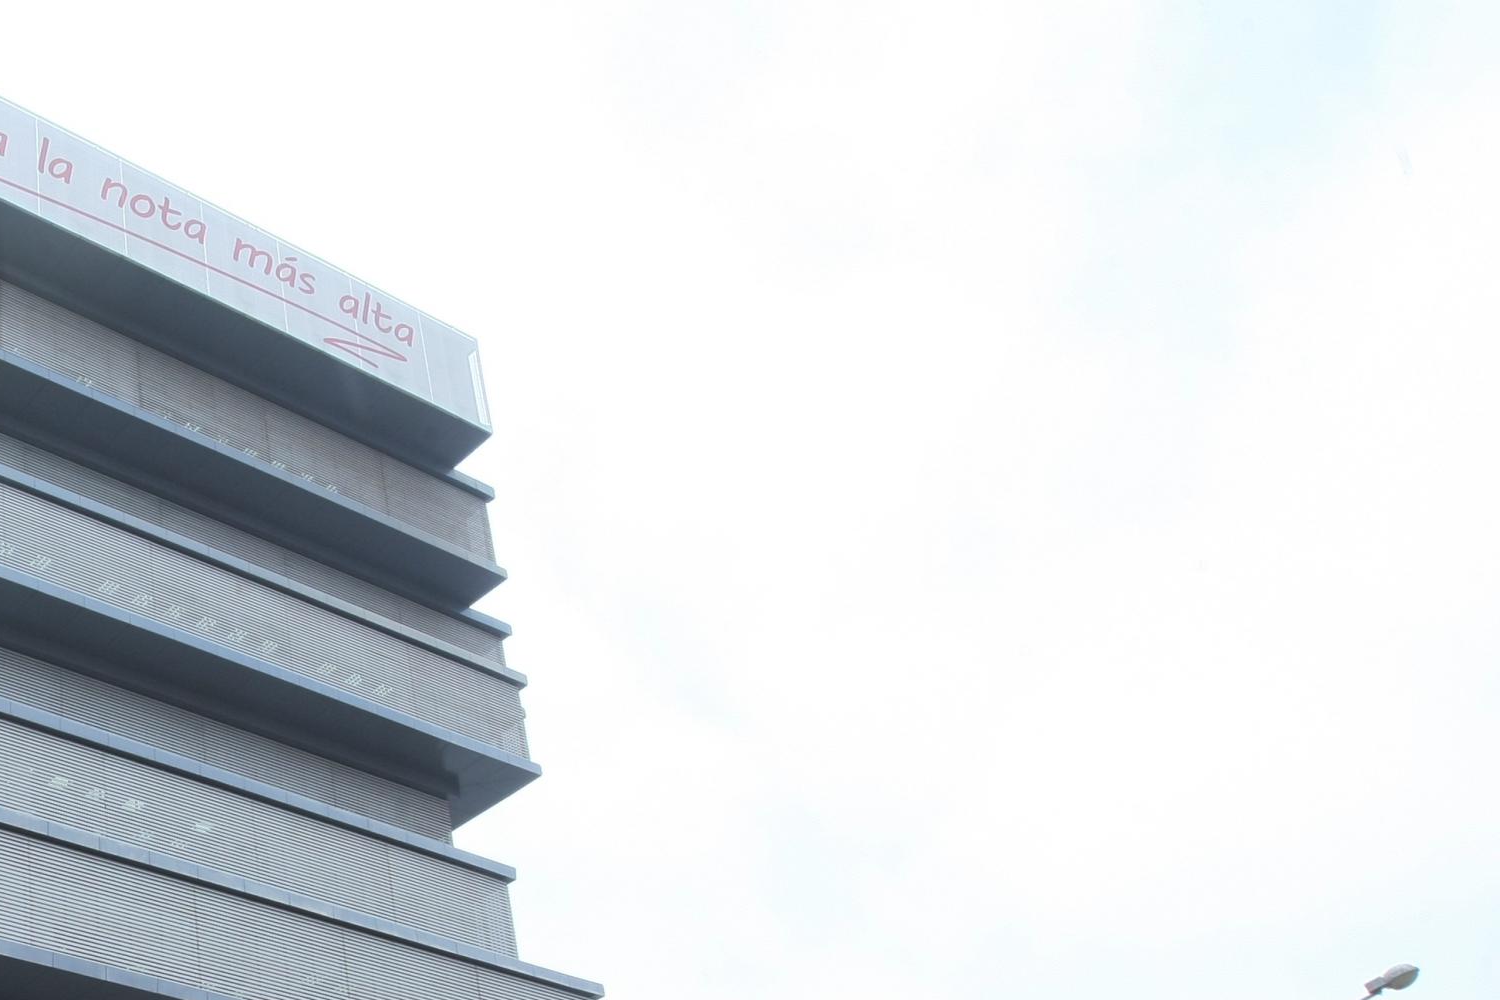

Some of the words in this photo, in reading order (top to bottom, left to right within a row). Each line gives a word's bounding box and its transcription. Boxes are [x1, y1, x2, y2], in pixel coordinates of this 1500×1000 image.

[37, 137, 74, 184] la
[100, 176, 208, 245] nota
[232, 237, 317, 294] más
[338, 291, 415, 347] alta
